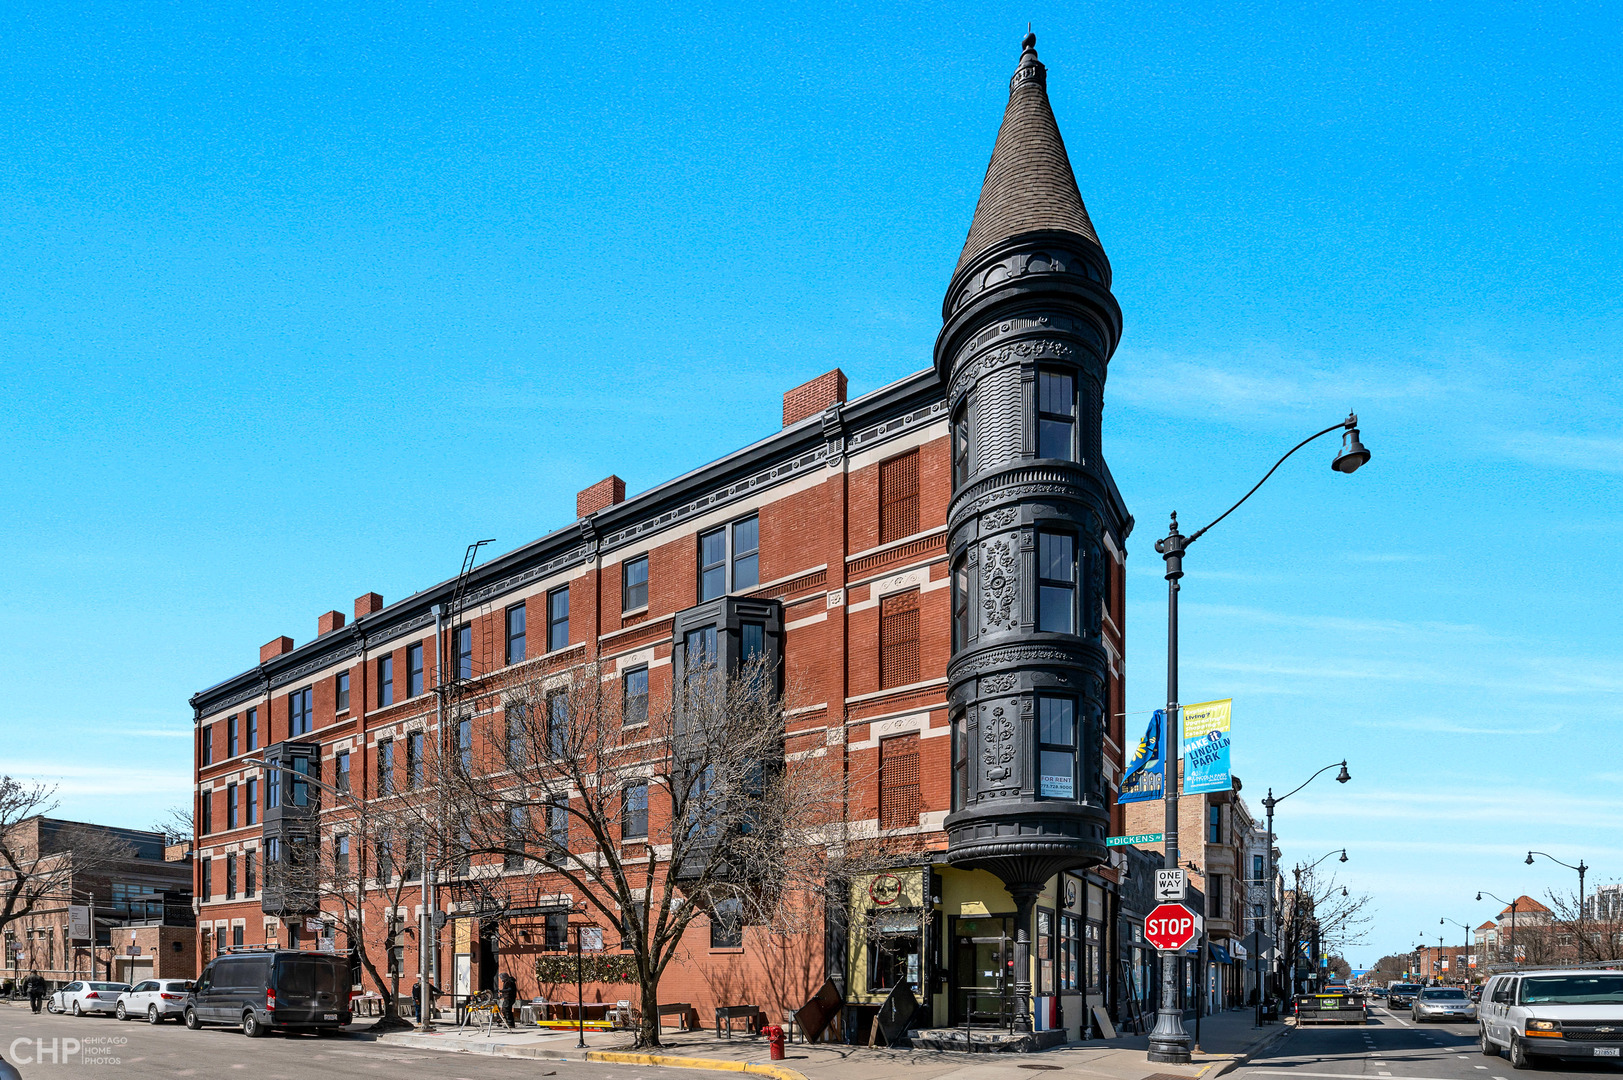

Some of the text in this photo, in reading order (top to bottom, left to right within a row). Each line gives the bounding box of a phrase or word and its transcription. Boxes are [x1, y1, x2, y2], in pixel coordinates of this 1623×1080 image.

[1185, 712, 1210, 720] Living?
[1184, 731, 1219, 753] MAKE it
[1189, 737, 1230, 760] LINCOLN
[1192, 751, 1221, 769] PARK
[1114, 834, 1155, 845] DICKENS
[1159, 871, 1181, 880] ONE
[1159, 880, 1181, 888] WAY
[1147, 918, 1192, 936] STOP
